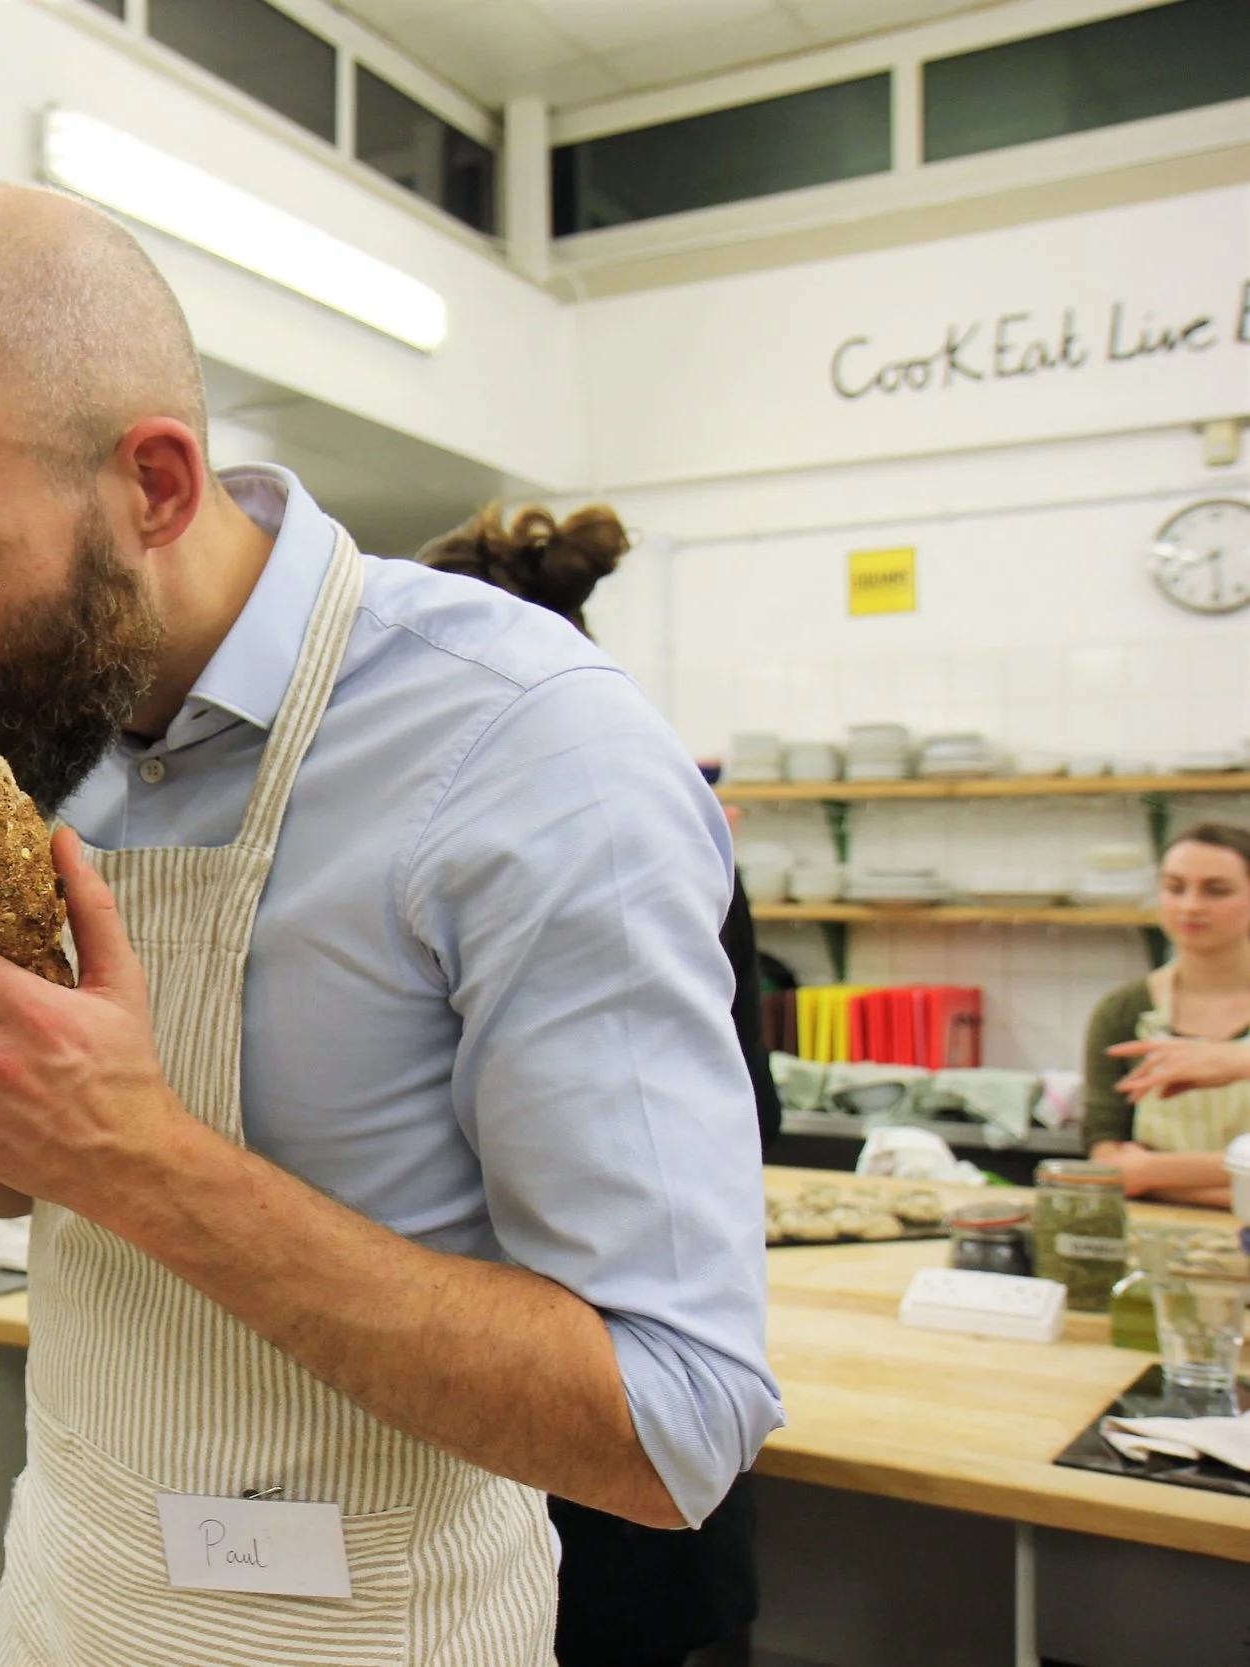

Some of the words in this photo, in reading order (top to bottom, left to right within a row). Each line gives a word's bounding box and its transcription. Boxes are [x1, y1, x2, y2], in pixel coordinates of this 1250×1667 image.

[993, 309, 1090, 379] Eat
[1105, 299, 1218, 361] Live
[197, 1518, 269, 1569] Paul
